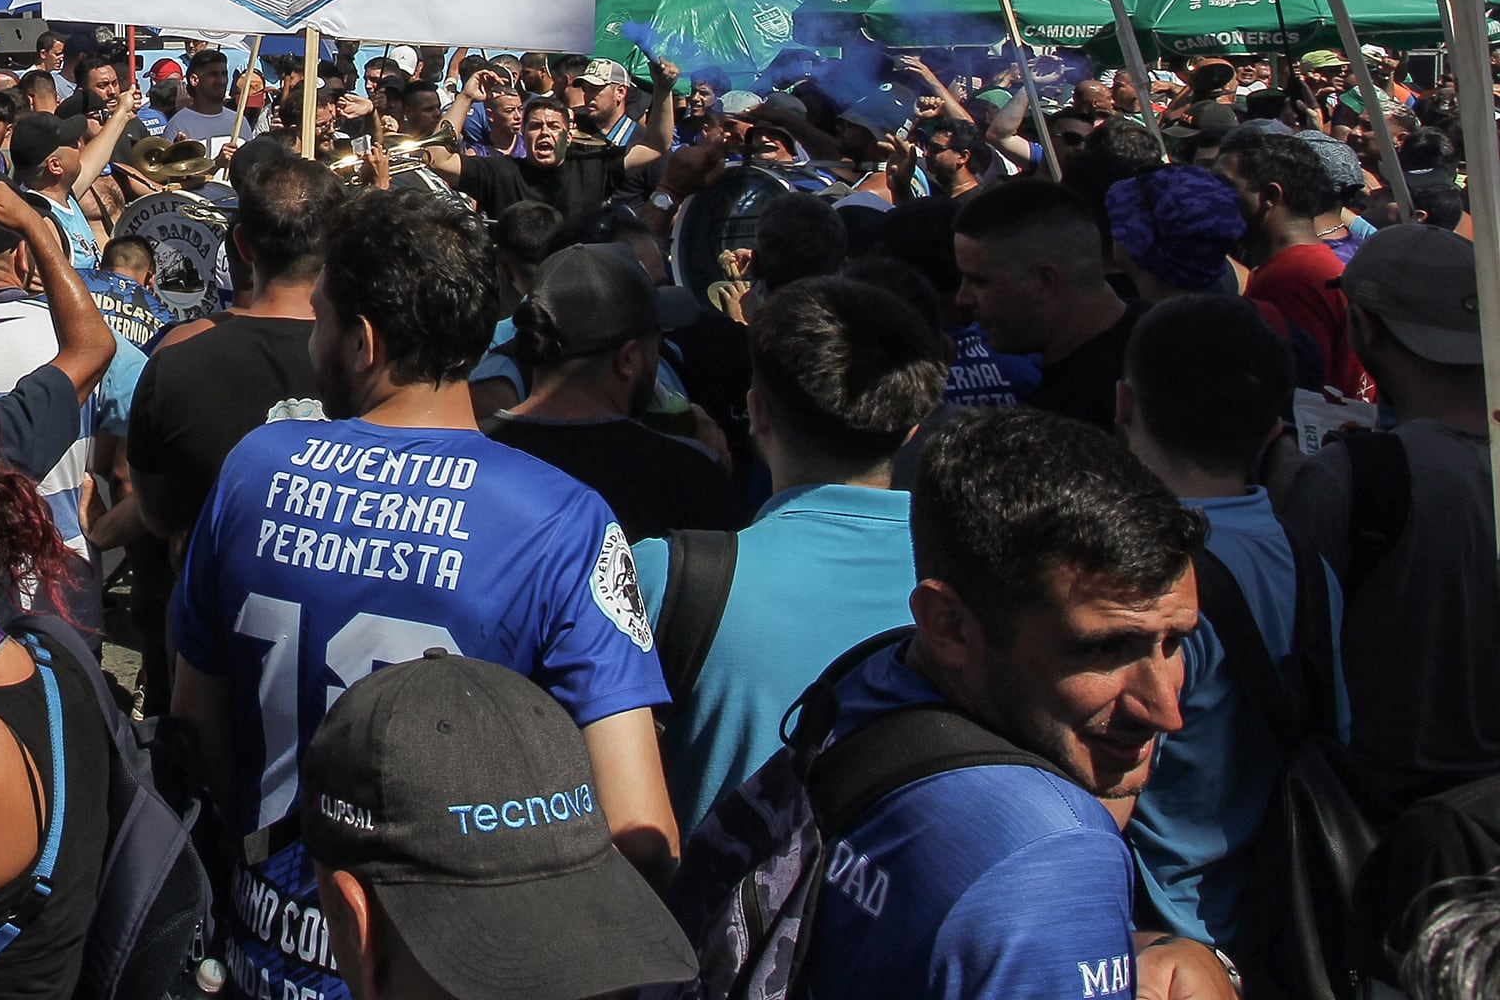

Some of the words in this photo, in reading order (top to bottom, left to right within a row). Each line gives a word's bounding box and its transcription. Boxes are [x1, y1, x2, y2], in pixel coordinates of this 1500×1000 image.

[151, 201, 168, 216] LA
[156, 222, 211, 259] BANDA
[945, 363, 1012, 390] RNAL
[290, 438, 478, 490] JUVENTUD
[265, 471, 470, 541] FRATERNAL
[256, 519, 464, 591] PERONISTA
[320, 793, 375, 832] CLIPSAL
[447, 783, 595, 835] Tecnova
